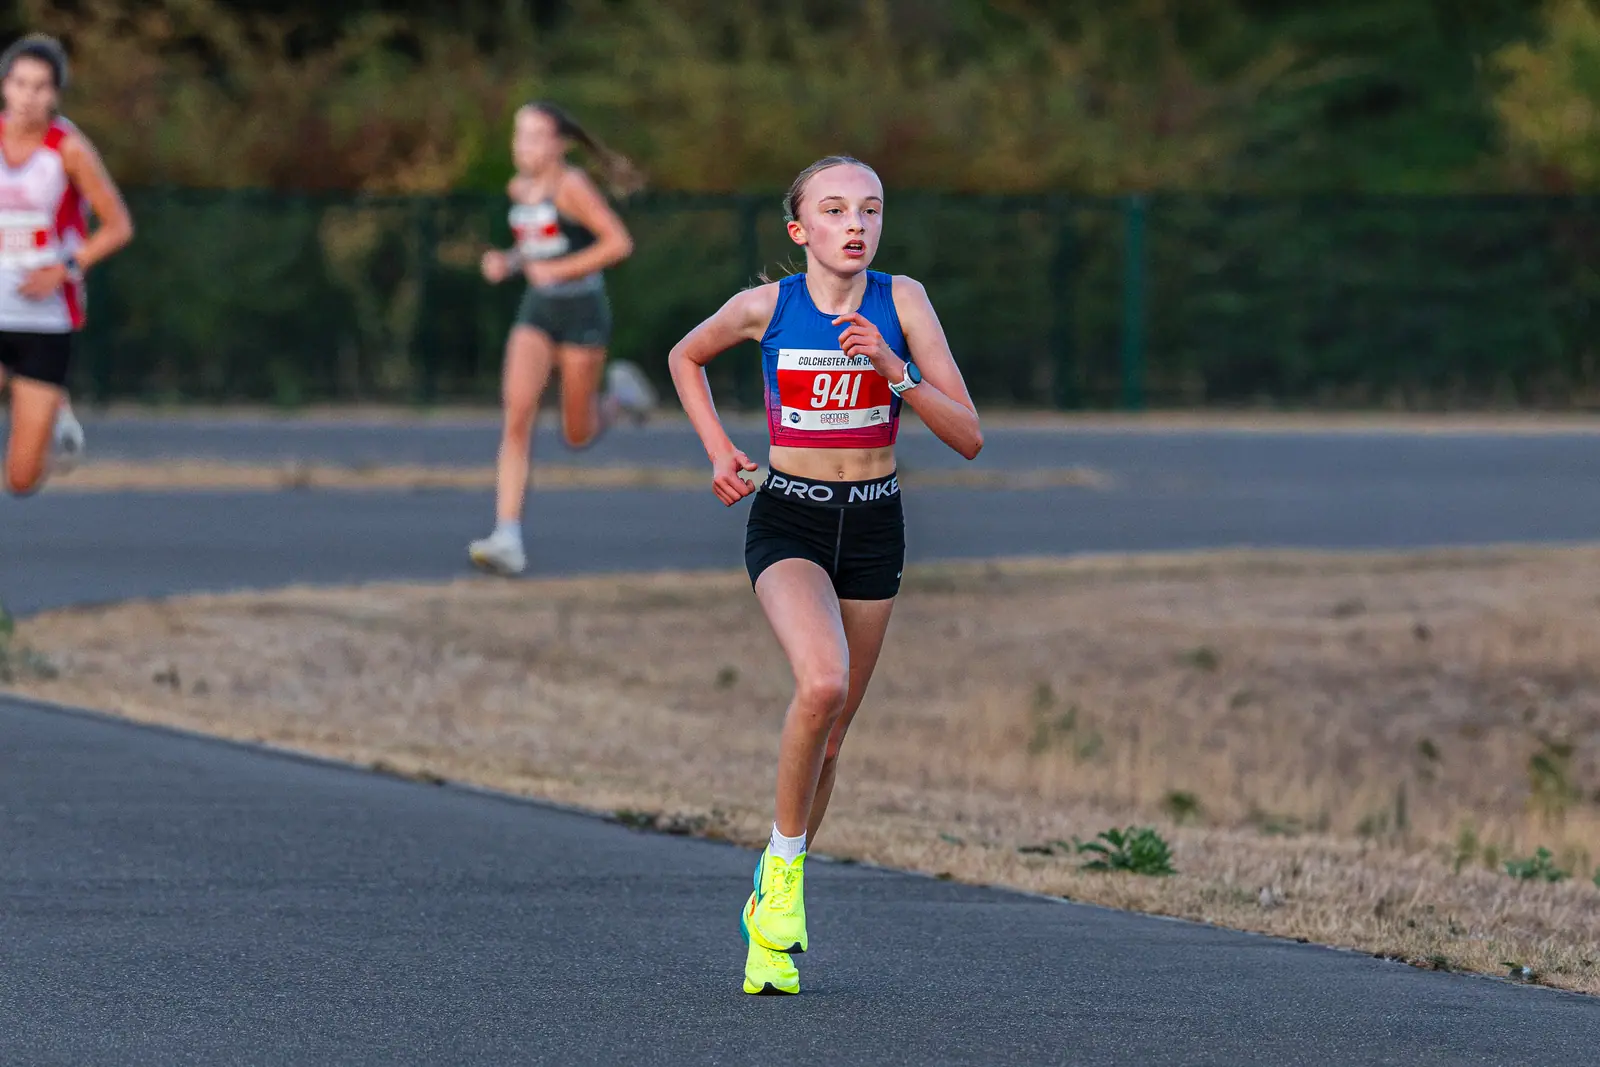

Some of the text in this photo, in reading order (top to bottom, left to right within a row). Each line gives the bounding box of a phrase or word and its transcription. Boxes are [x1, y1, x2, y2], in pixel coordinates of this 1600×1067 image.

[798, 356, 845, 366] COLCHESTER
[847, 356, 862, 366] FNR
[810, 373, 862, 408] 941
[768, 474, 834, 502] PRO
[848, 475, 899, 503] NIKE
